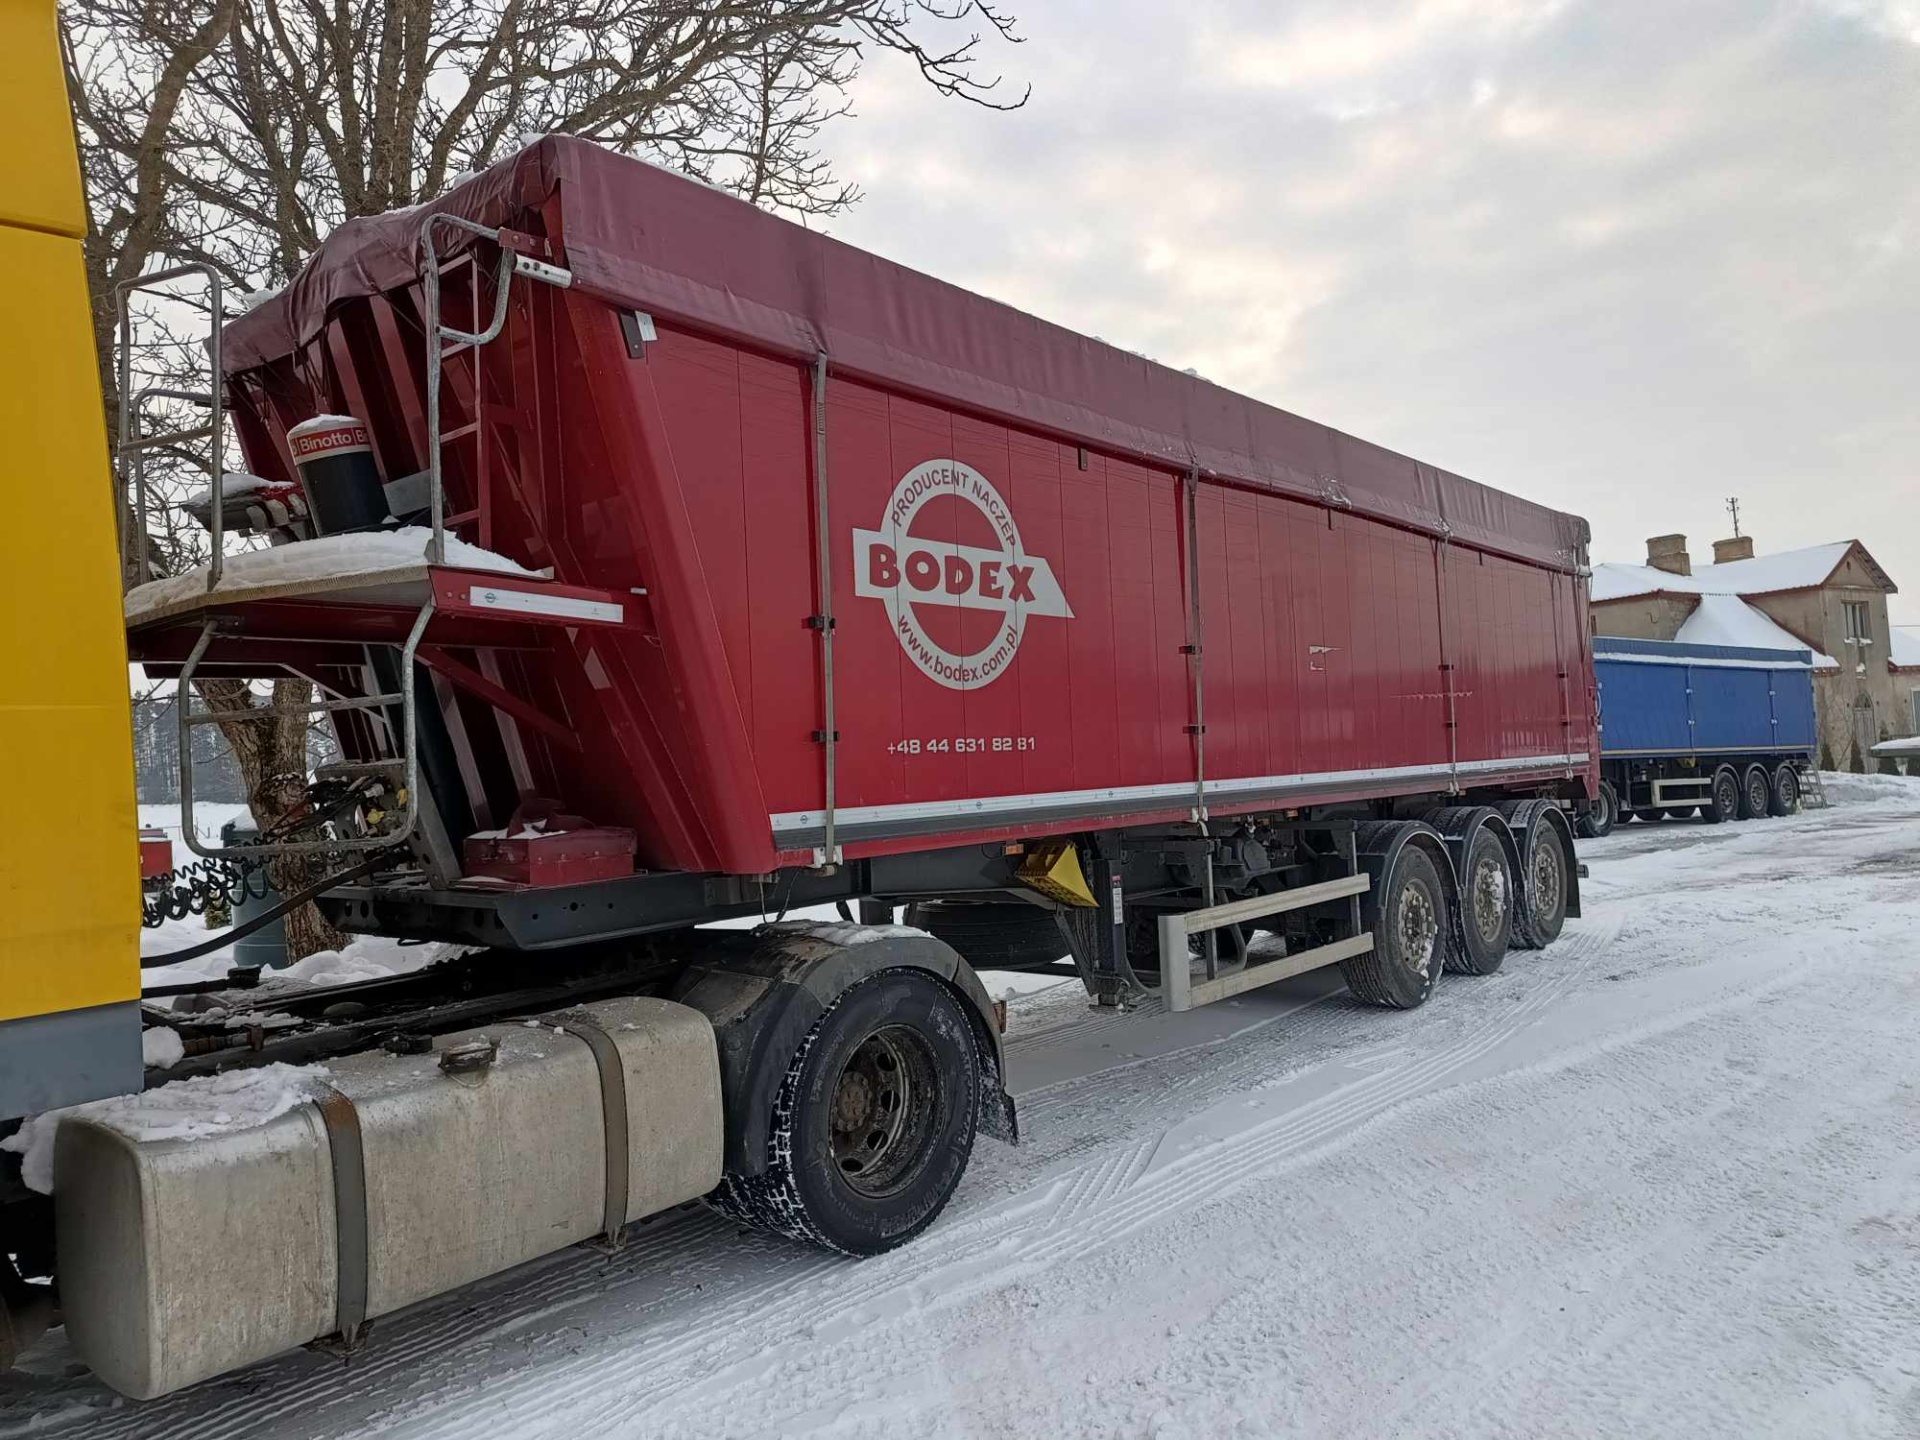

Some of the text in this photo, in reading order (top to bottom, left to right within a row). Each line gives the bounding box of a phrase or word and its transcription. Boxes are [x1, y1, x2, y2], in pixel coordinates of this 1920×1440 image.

[300, 432, 352, 452] Binotto
[891, 468, 1016, 546] PRODUCENT NACZEP
[869, 543, 1036, 603] BODEX
[899, 615, 1018, 682] www.bodex.com.pl
[887, 736, 1036, 754] +48 44 631 82 81
